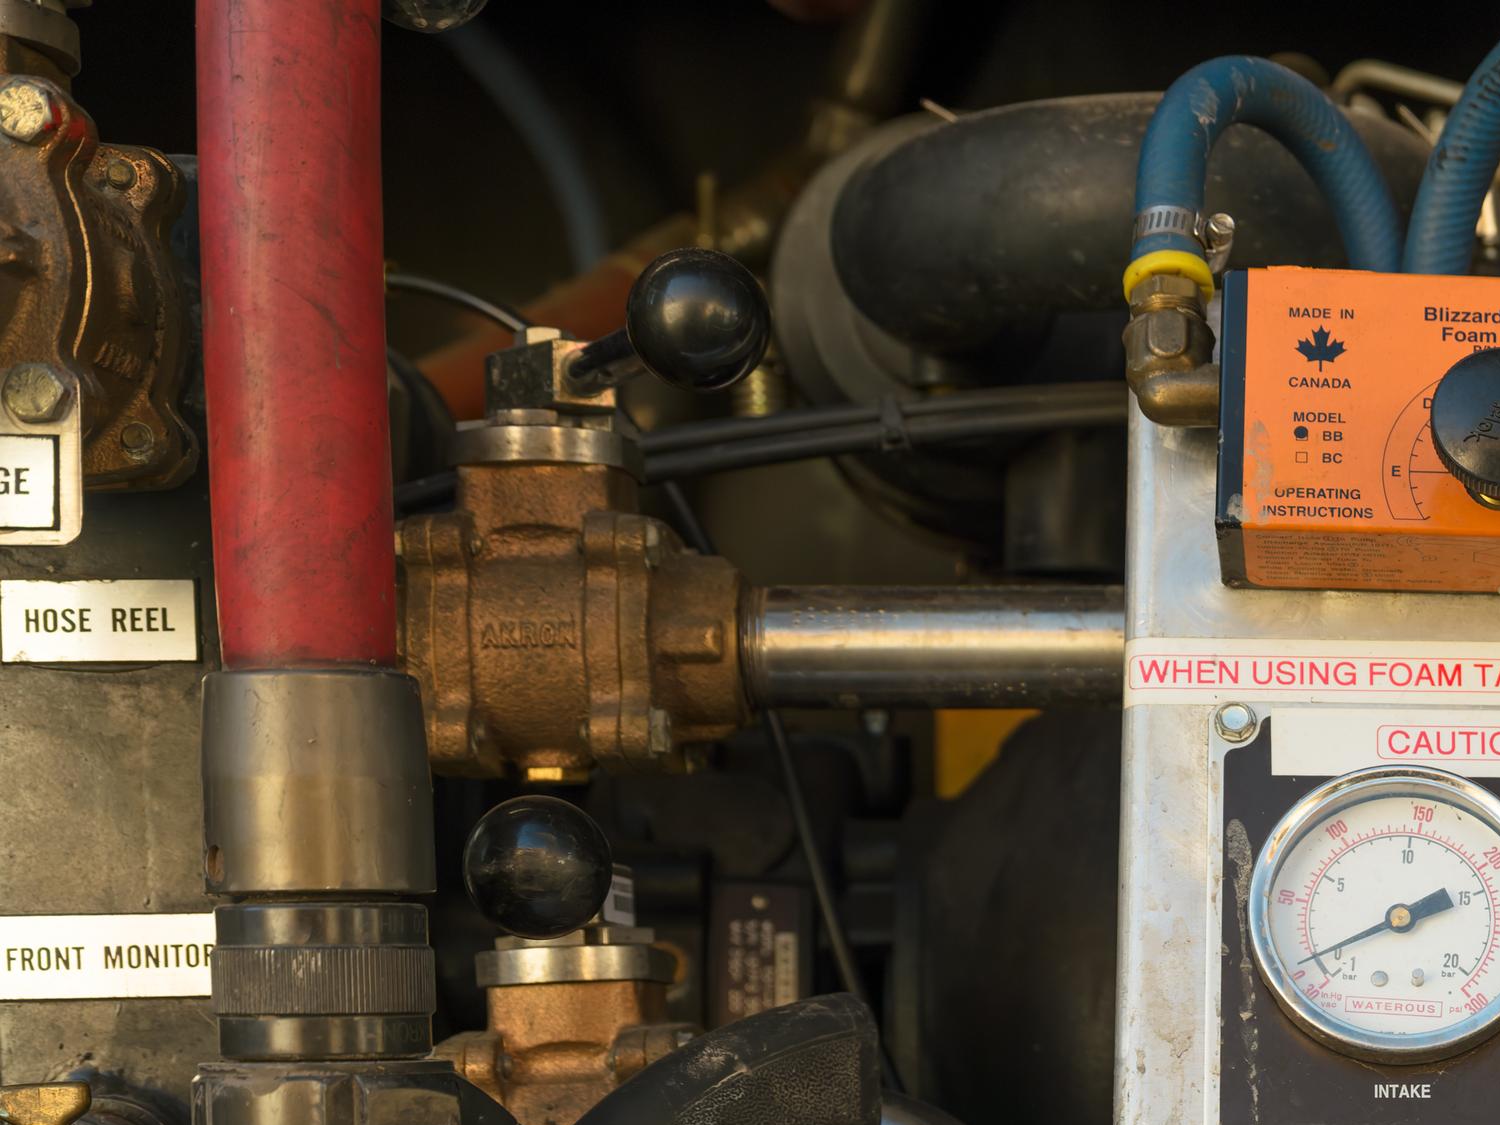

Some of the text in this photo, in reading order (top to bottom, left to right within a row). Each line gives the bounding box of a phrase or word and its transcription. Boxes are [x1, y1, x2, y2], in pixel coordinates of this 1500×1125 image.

[1289, 308, 1354, 319] MADE IN
[1442, 327, 1497, 343] Foam
[1288, 377, 1351, 389] CANADA
[1293, 412, 1346, 423] MODEL
[1323, 431, 1343, 441] BB
[1322, 453, 1343, 463] BC
[1392, 465, 1400, 477] E
[1274, 488, 1361, 500] OPERATING
[1263, 506, 1373, 519] INSTRUCTIONS
[25, 607, 175, 632] HOSE REEL
[482, 621, 577, 649] AKRON
[1140, 660, 1239, 684] WHEN
[1252, 661, 1357, 686] USING
[1369, 663, 1463, 687] FOAM
[1413, 805, 1434, 823] 150
[1325, 820, 1347, 838] 100
[1401, 850, 1414, 864] 10
[1337, 878, 1345, 892] 5
[1277, 889, 1296, 906] 50
[1458, 892, 1471, 905] 15
[7, 946, 85, 971] FRONT
[1441, 953, 1459, 978] 20 bar
[1343, 972, 1357, 980] bar
[1352, 1000, 1436, 1013] WATEROUS
[1464, 992, 1489, 1015] 300
[1374, 1084, 1431, 1098] INTAKE
